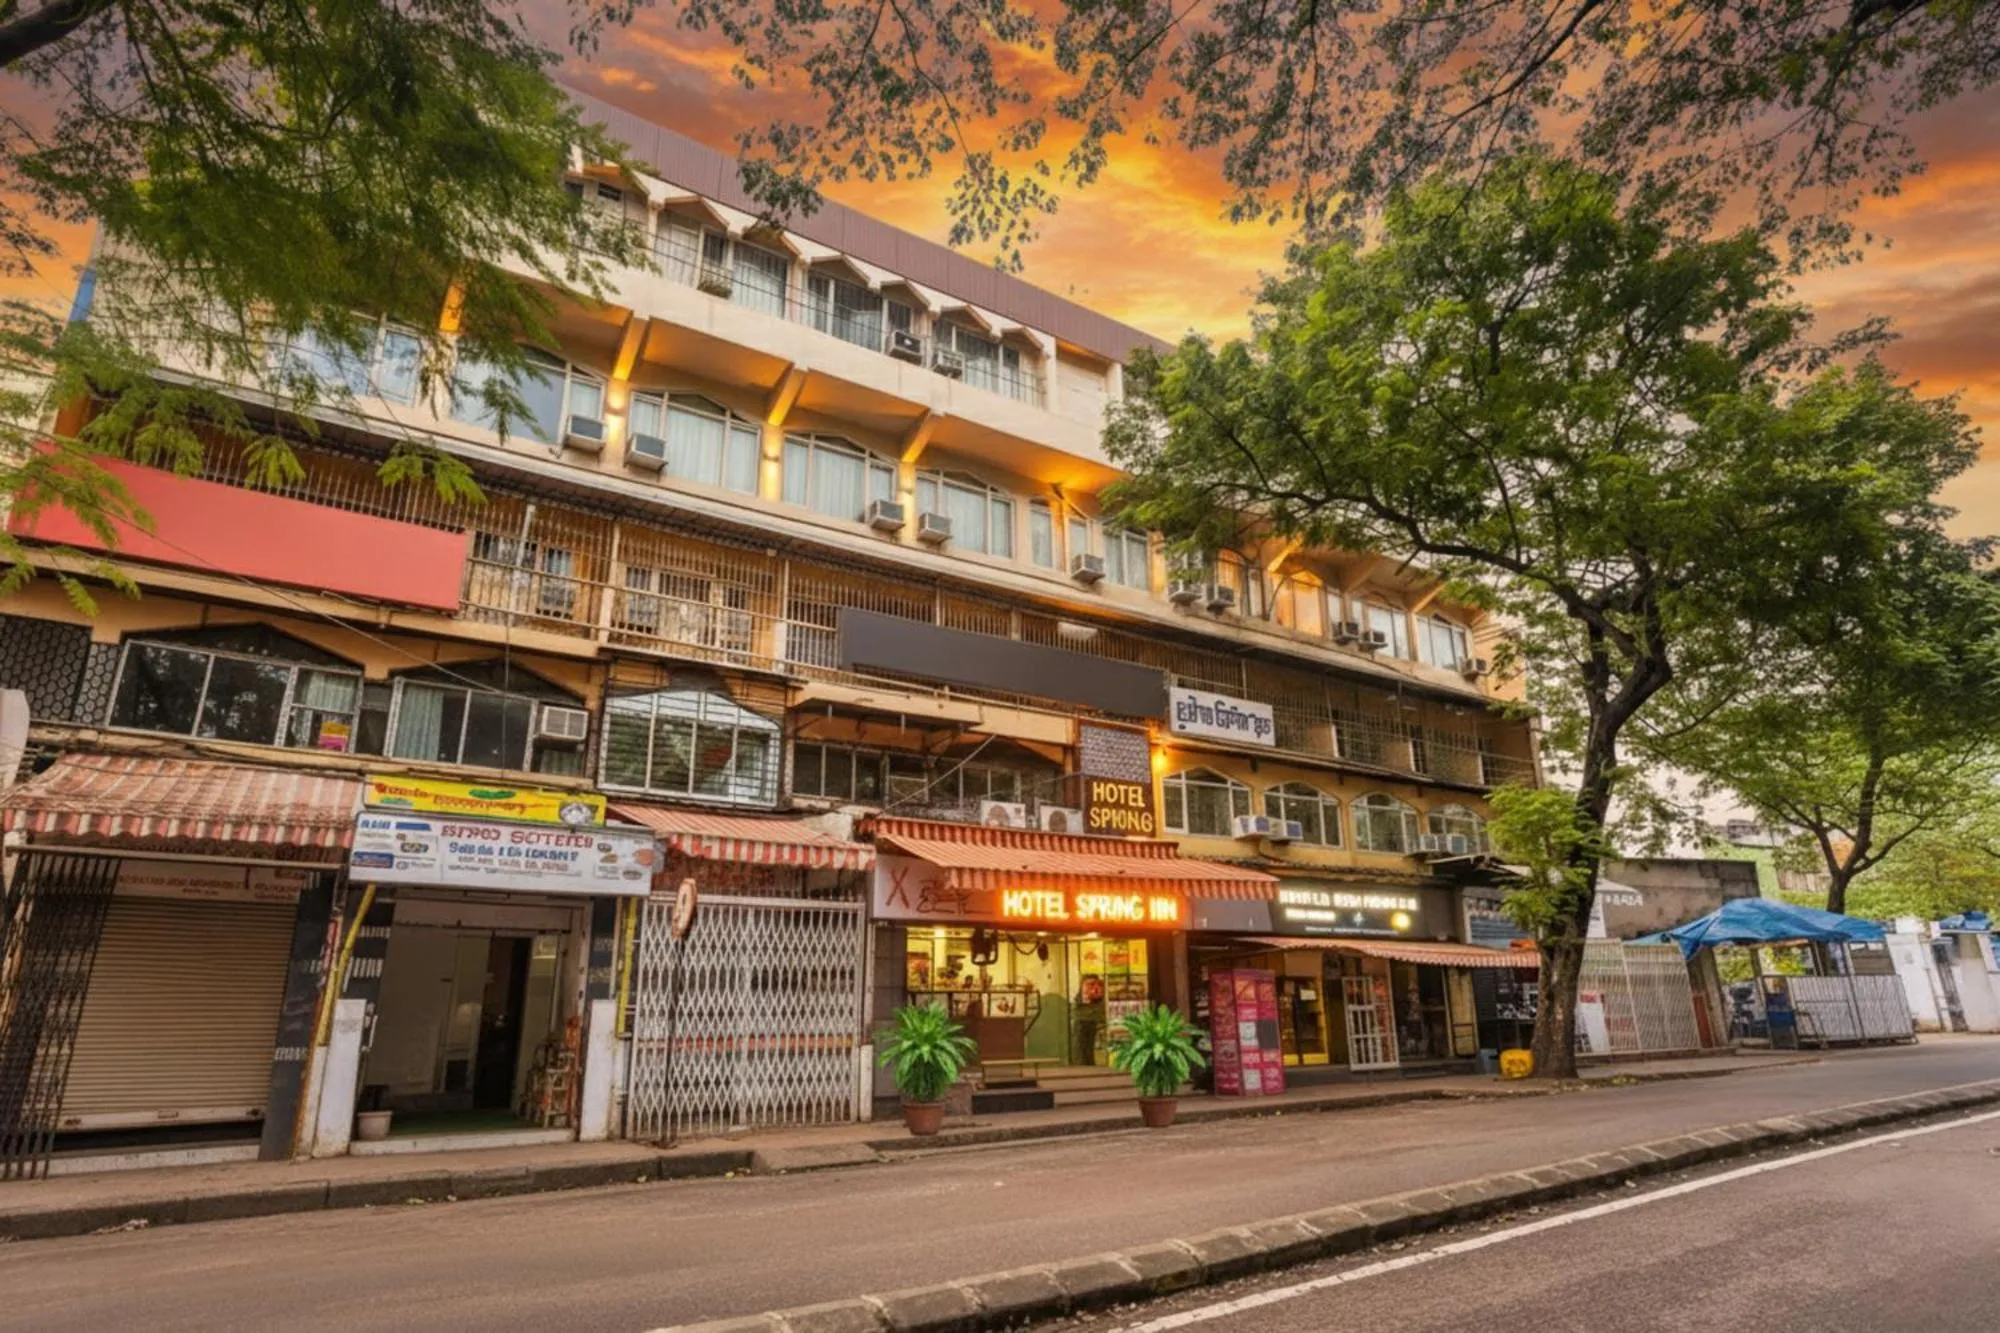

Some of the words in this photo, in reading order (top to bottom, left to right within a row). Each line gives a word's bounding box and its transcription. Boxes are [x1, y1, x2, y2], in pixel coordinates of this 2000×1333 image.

[1092, 781, 1145, 807] HOTEL
[1002, 889, 1069, 920] HOTEL
[1075, 892, 1145, 922] SPRING
